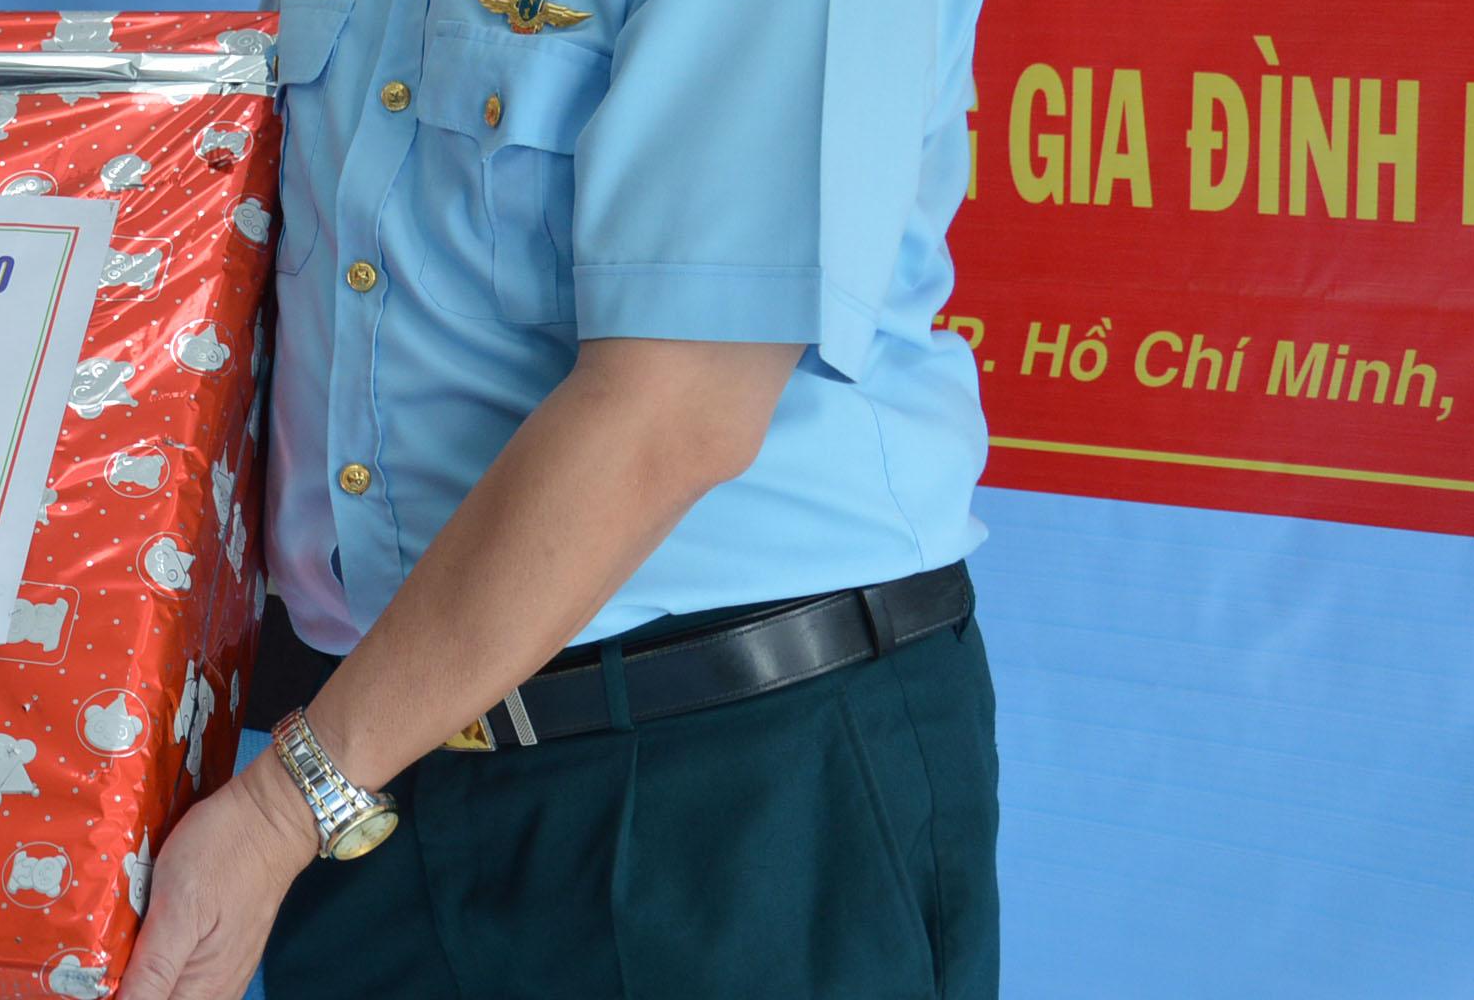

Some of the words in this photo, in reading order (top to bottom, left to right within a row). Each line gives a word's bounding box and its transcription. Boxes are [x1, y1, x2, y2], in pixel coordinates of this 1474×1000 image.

[1008, 63, 1153, 209] GIA
[1187, 35, 1420, 223] ĐÌNH
[929, 314, 995, 373] P.
[1020, 317, 1112, 381] Hồ
[1134, 330, 1251, 392] Chí
[1266, 341, 1455, 422] Minh,
